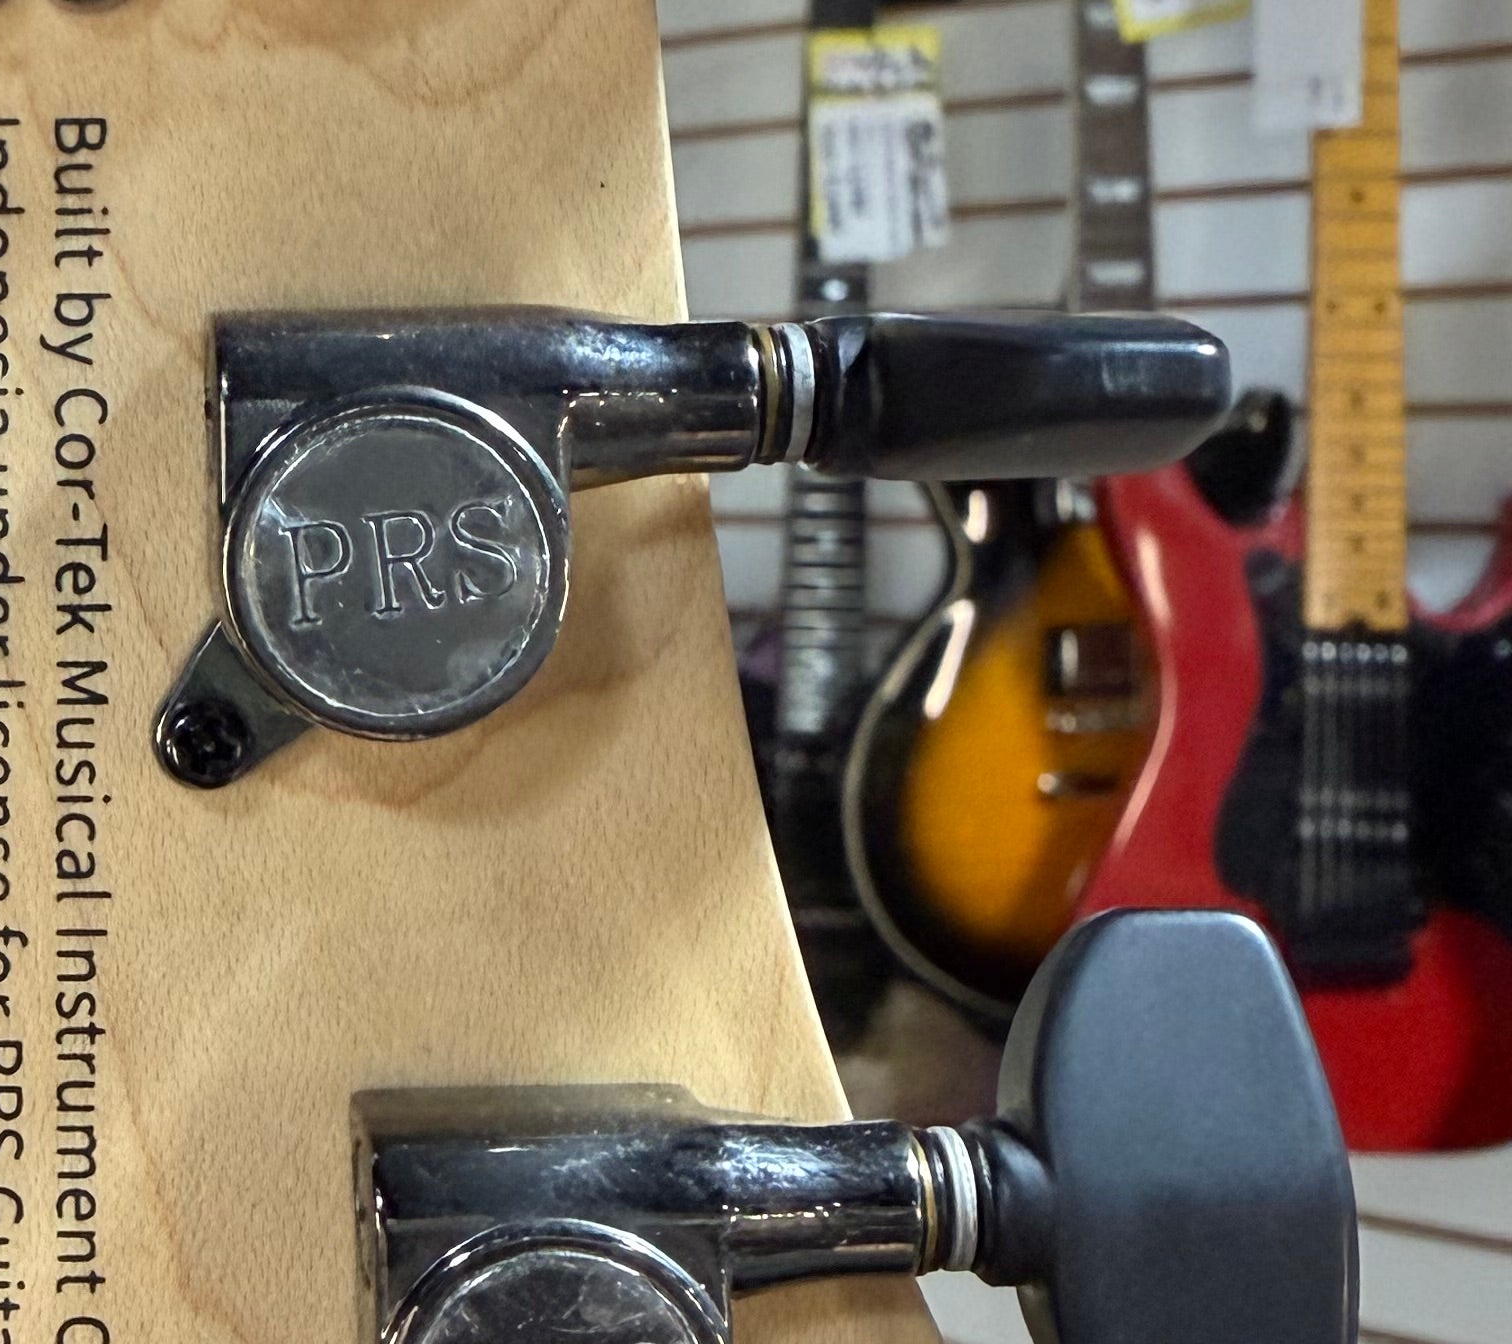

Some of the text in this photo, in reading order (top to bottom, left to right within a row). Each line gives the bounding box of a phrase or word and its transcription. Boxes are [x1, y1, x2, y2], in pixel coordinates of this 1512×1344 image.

[54, 117, 112, 269] Built
[41, 292, 112, 366] by
[54, 388, 113, 635] Cor-Tek
[278, 497, 520, 629] PRS
[55, 659, 113, 904] Musical
[55, 928, 109, 1295] Instrument
